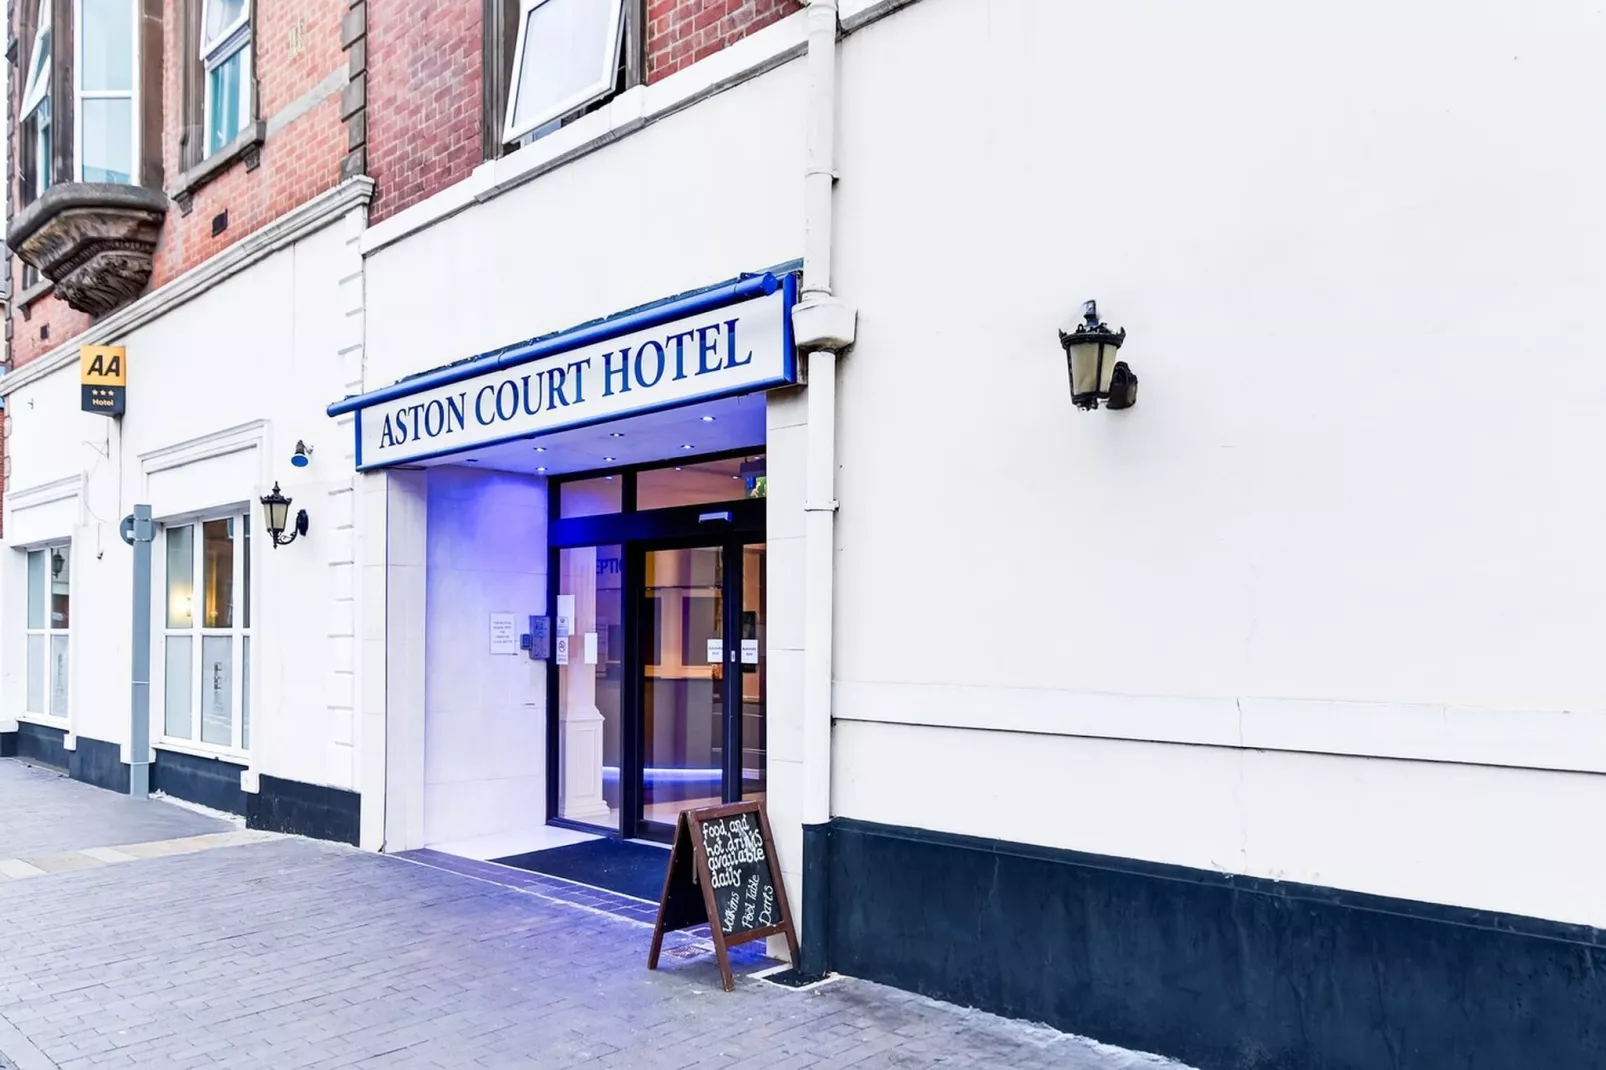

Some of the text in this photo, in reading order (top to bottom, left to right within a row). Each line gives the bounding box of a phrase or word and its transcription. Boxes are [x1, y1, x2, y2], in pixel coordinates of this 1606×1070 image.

[86, 354, 120, 377] AA
[379, 317, 752, 449] ASTON COURT HOTEL
[92, 398, 114, 406] Hotel
[729, 813, 750, 834] and
[703, 837, 724, 857] hot
[707, 847, 766, 871] available
[711, 866, 742, 888] daily
[741, 874, 760, 929] Pool Table
[758, 885, 774, 927] Darts
